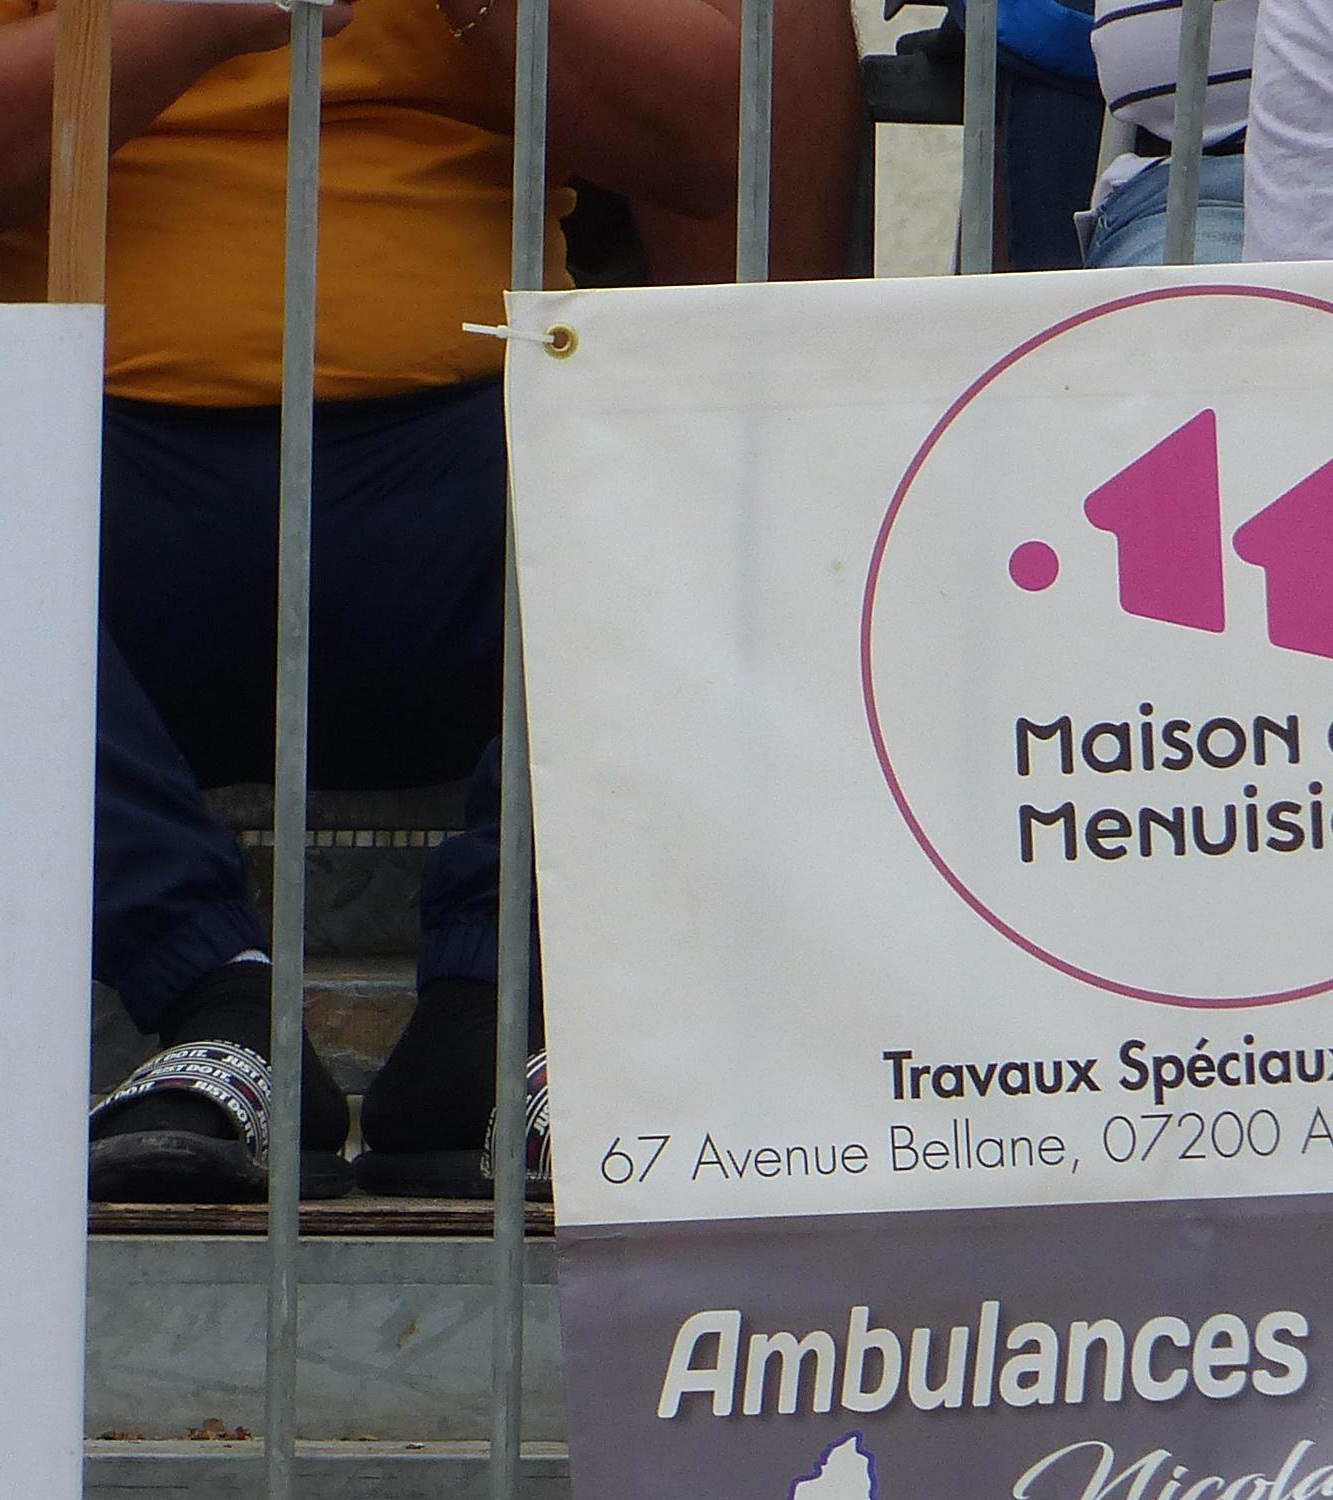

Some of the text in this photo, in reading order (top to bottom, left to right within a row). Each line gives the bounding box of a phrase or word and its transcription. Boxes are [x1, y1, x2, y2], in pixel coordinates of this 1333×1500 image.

[1017, 703, 1299, 776] Maison
[1020, 783, 1333, 864] Menuisi
[884, 1032, 1333, 1106] Travaux Spéciau
[601, 1134, 671, 1185] 67
[692, 1131, 869, 1181] Avenue
[891, 1117, 1083, 1175] Bellane,
[1103, 1107, 1281, 1163] 07200
[657, 1300, 1310, 1420] Ambulances
